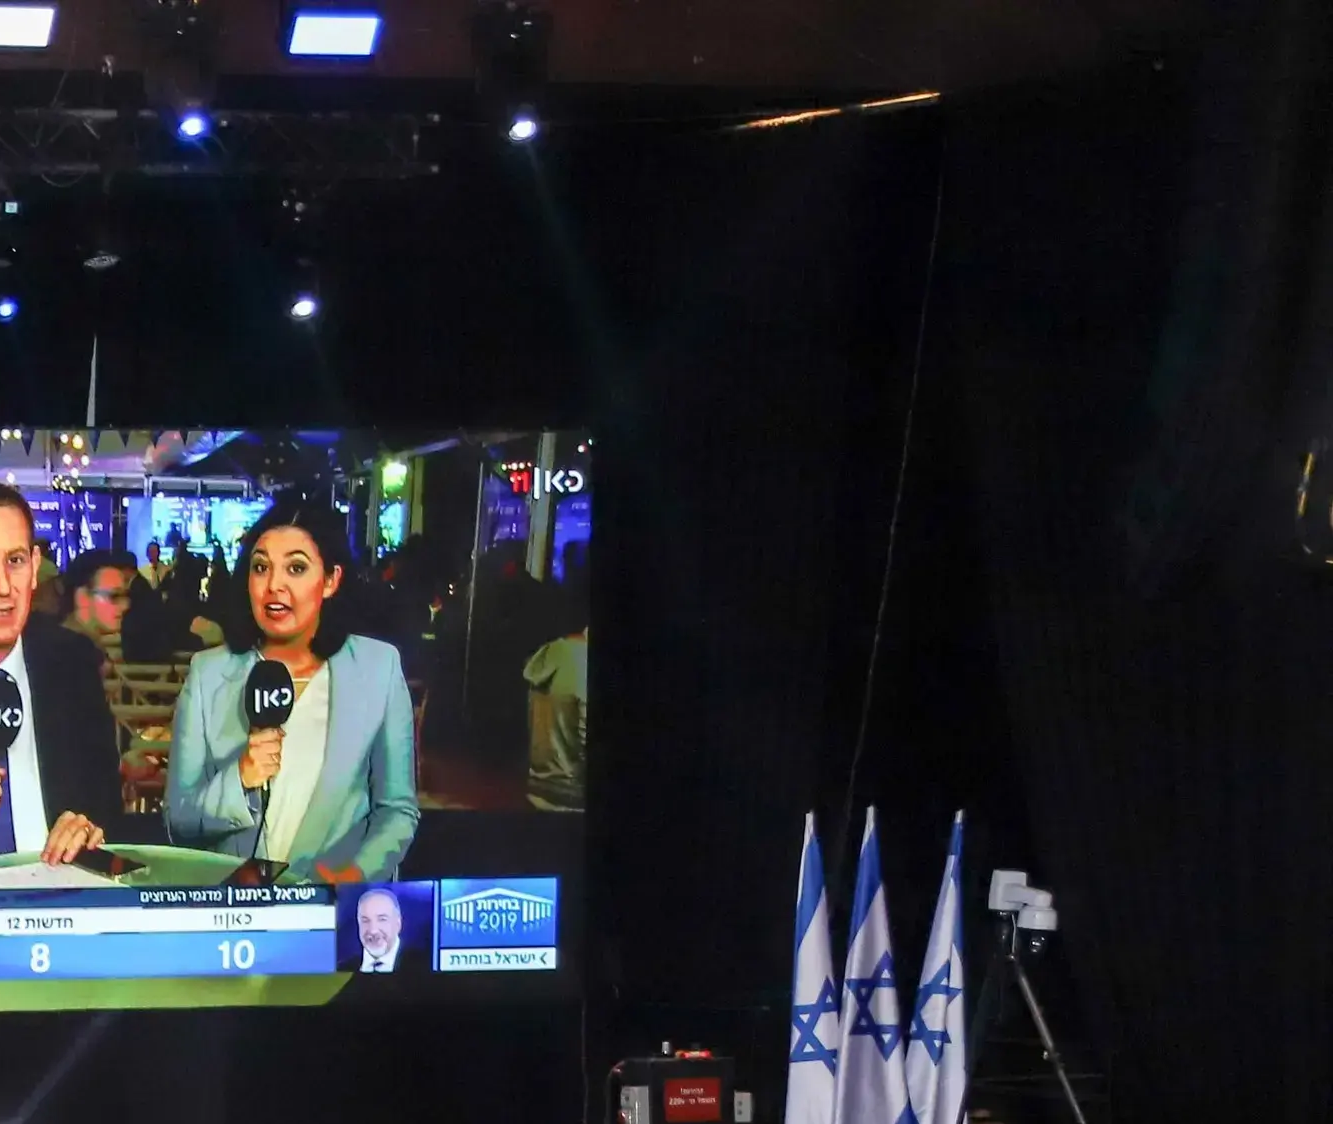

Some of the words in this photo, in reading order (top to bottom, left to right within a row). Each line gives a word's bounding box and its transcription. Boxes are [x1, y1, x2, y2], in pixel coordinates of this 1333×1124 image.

[533, 467, 584, 499] כאן
[254, 687, 293, 714] כאן
[235, 887, 271, 902] ביתנו
[273, 886, 316, 901] ישראל
[7, 917, 21, 930] 12
[24, 915, 74, 930] חדשות
[479, 911, 518, 928] 2019
[29, 942, 51, 974] 8
[217, 939, 256, 970] 10
[449, 953, 492, 966] בוחרת
[494, 950, 537, 966] ישראל
